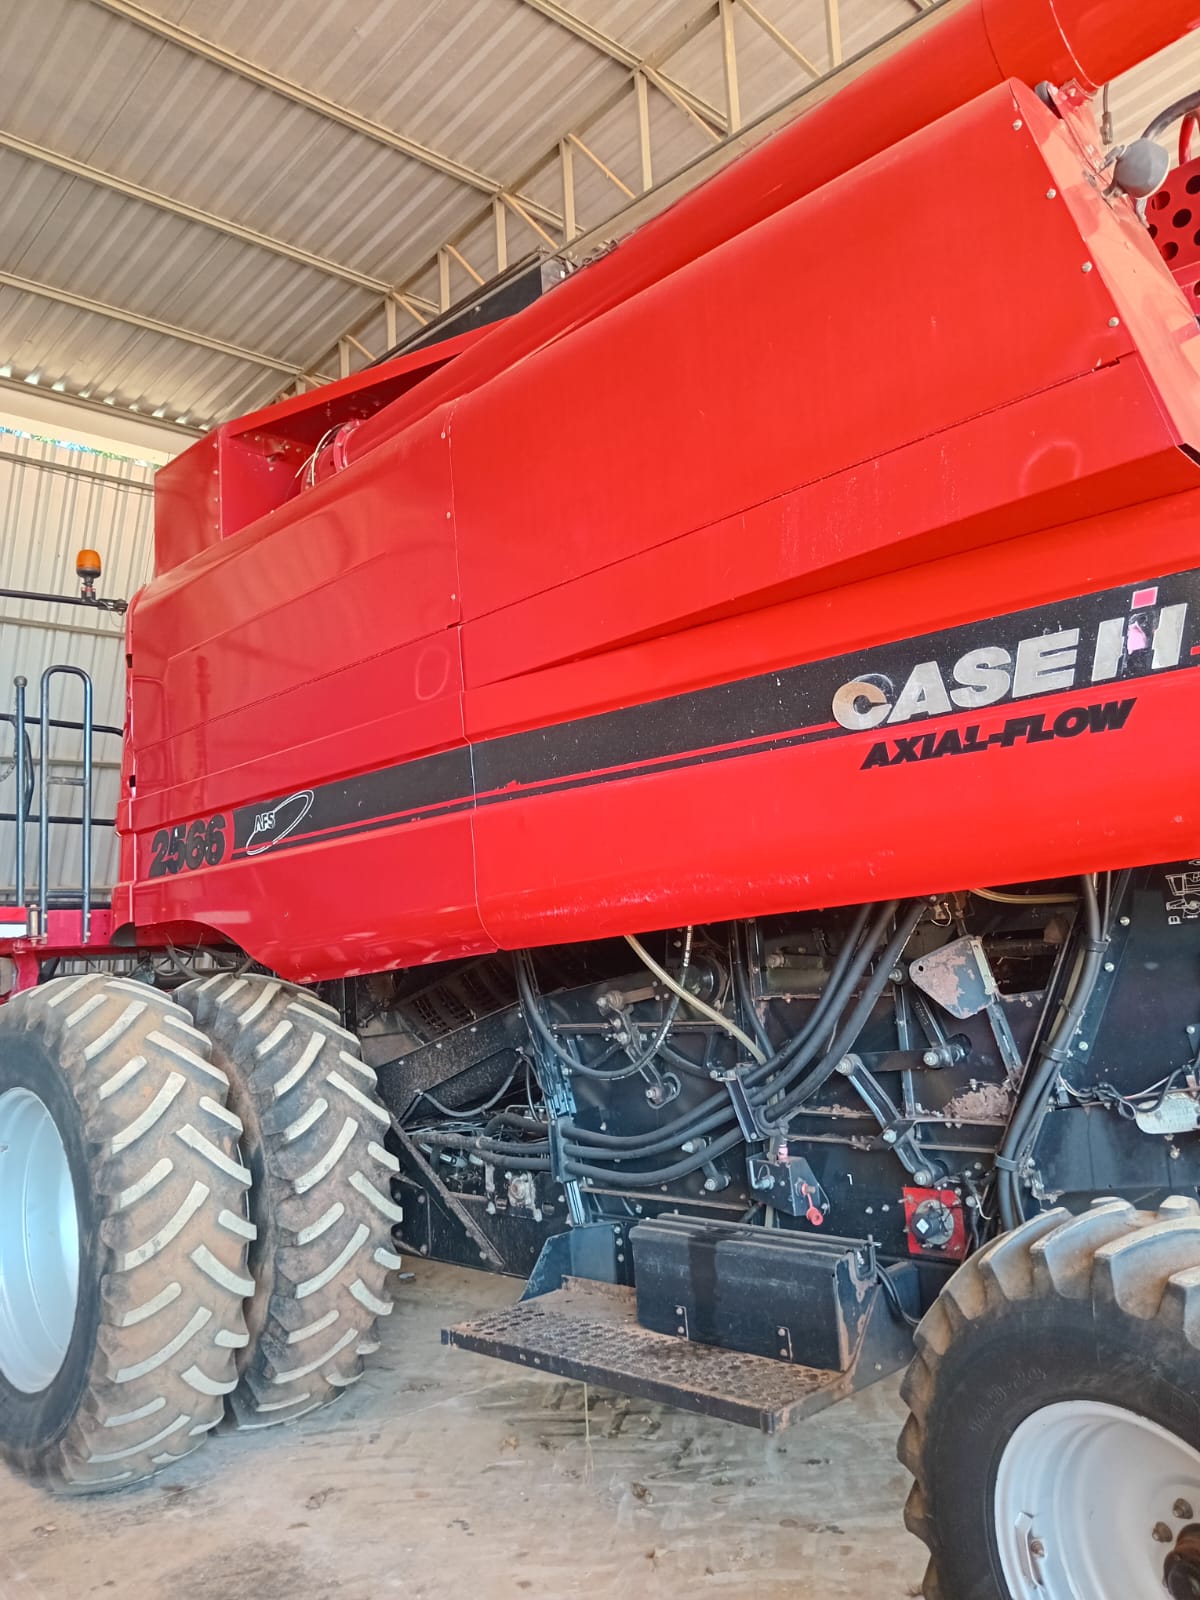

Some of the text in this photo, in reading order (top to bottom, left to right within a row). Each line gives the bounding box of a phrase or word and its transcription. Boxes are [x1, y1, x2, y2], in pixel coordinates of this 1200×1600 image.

[832, 627, 1080, 731] CASE
[860, 697, 1138, 770] AXIAL-FLOW
[147, 813, 227, 879] 2566
[253, 810, 276, 833] AFS
